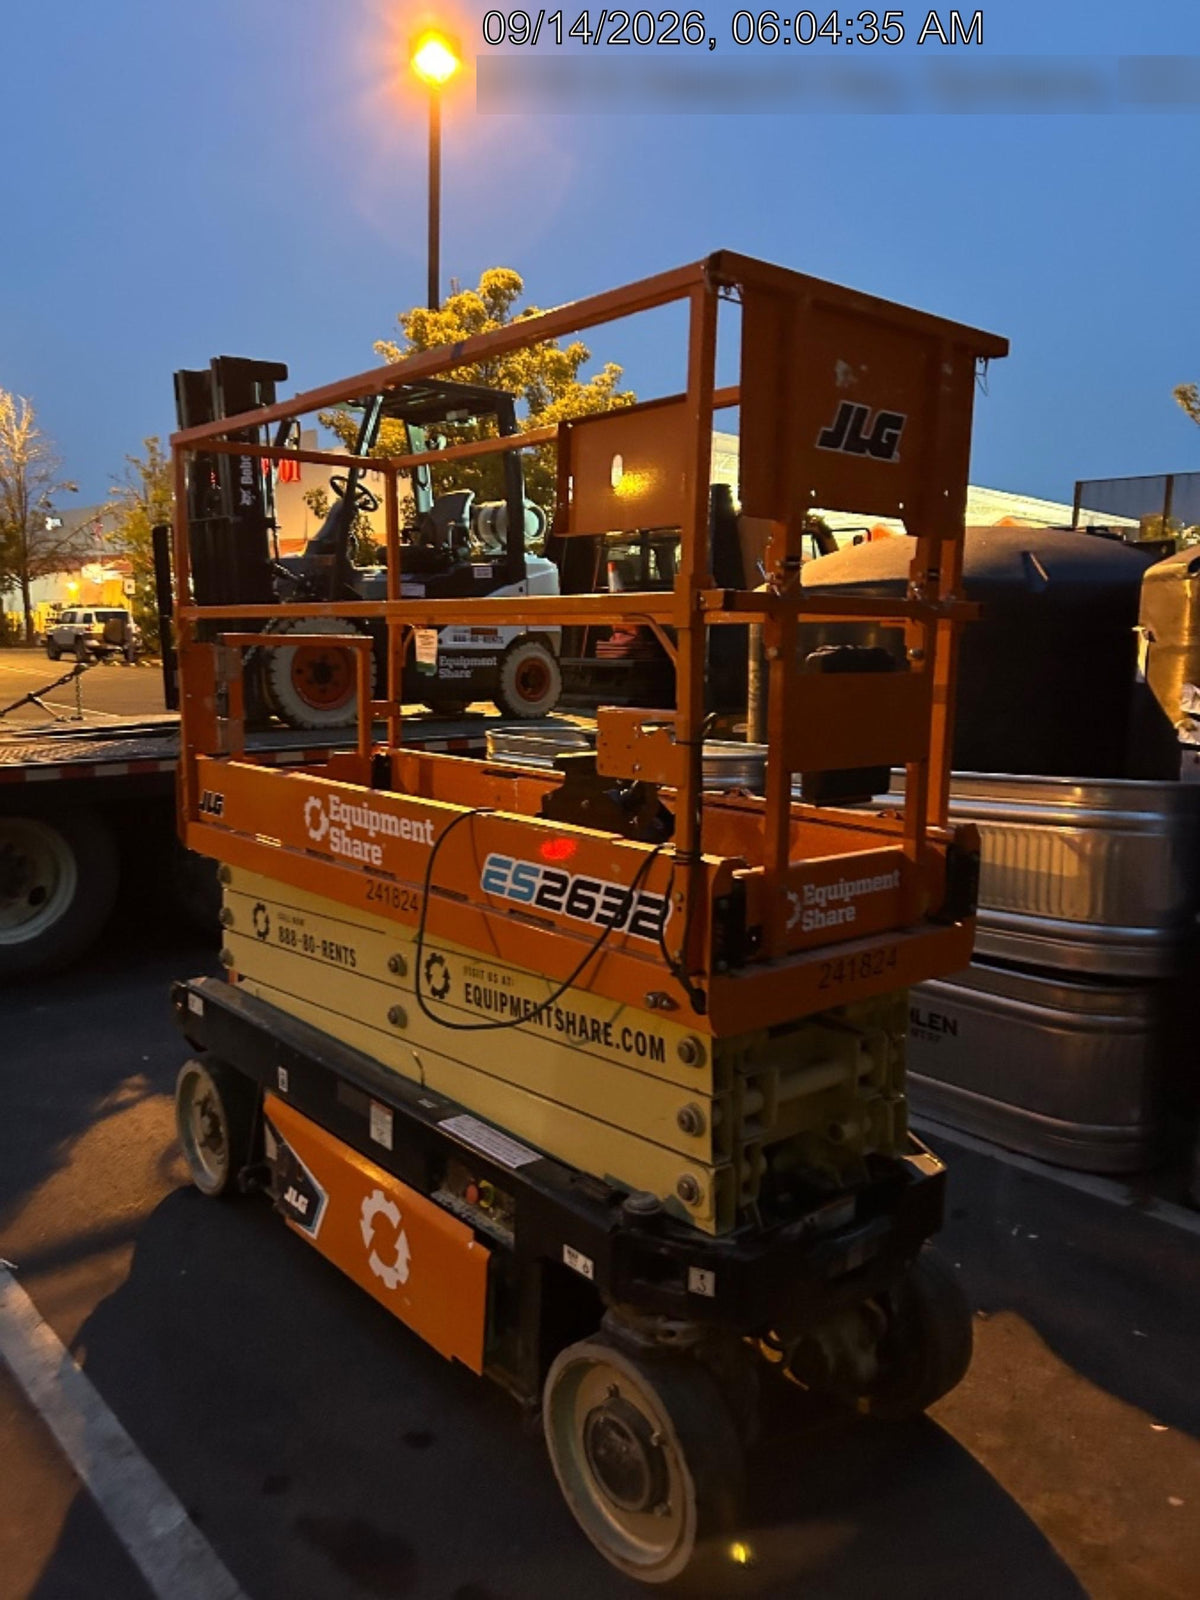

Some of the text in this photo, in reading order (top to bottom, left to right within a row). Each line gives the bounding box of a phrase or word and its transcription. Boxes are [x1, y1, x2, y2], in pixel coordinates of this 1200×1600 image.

[816, 400, 907, 462] JLG
[200, 790, 225, 817] JLG
[328, 794, 436, 847] Equipment
[329, 826, 384, 866] Share
[365, 879, 419, 912] 241824
[481, 853, 672, 944] ES2632
[803, 869, 900, 907] Equipment
[802, 906, 856, 932] Share
[278, 926, 357, 968] 888-80-RENTS
[817, 946, 898, 990] 241824
[464, 983, 666, 1063] EQUIPMENTSHARE.COM
[283, 1186, 309, 1214] JLG
